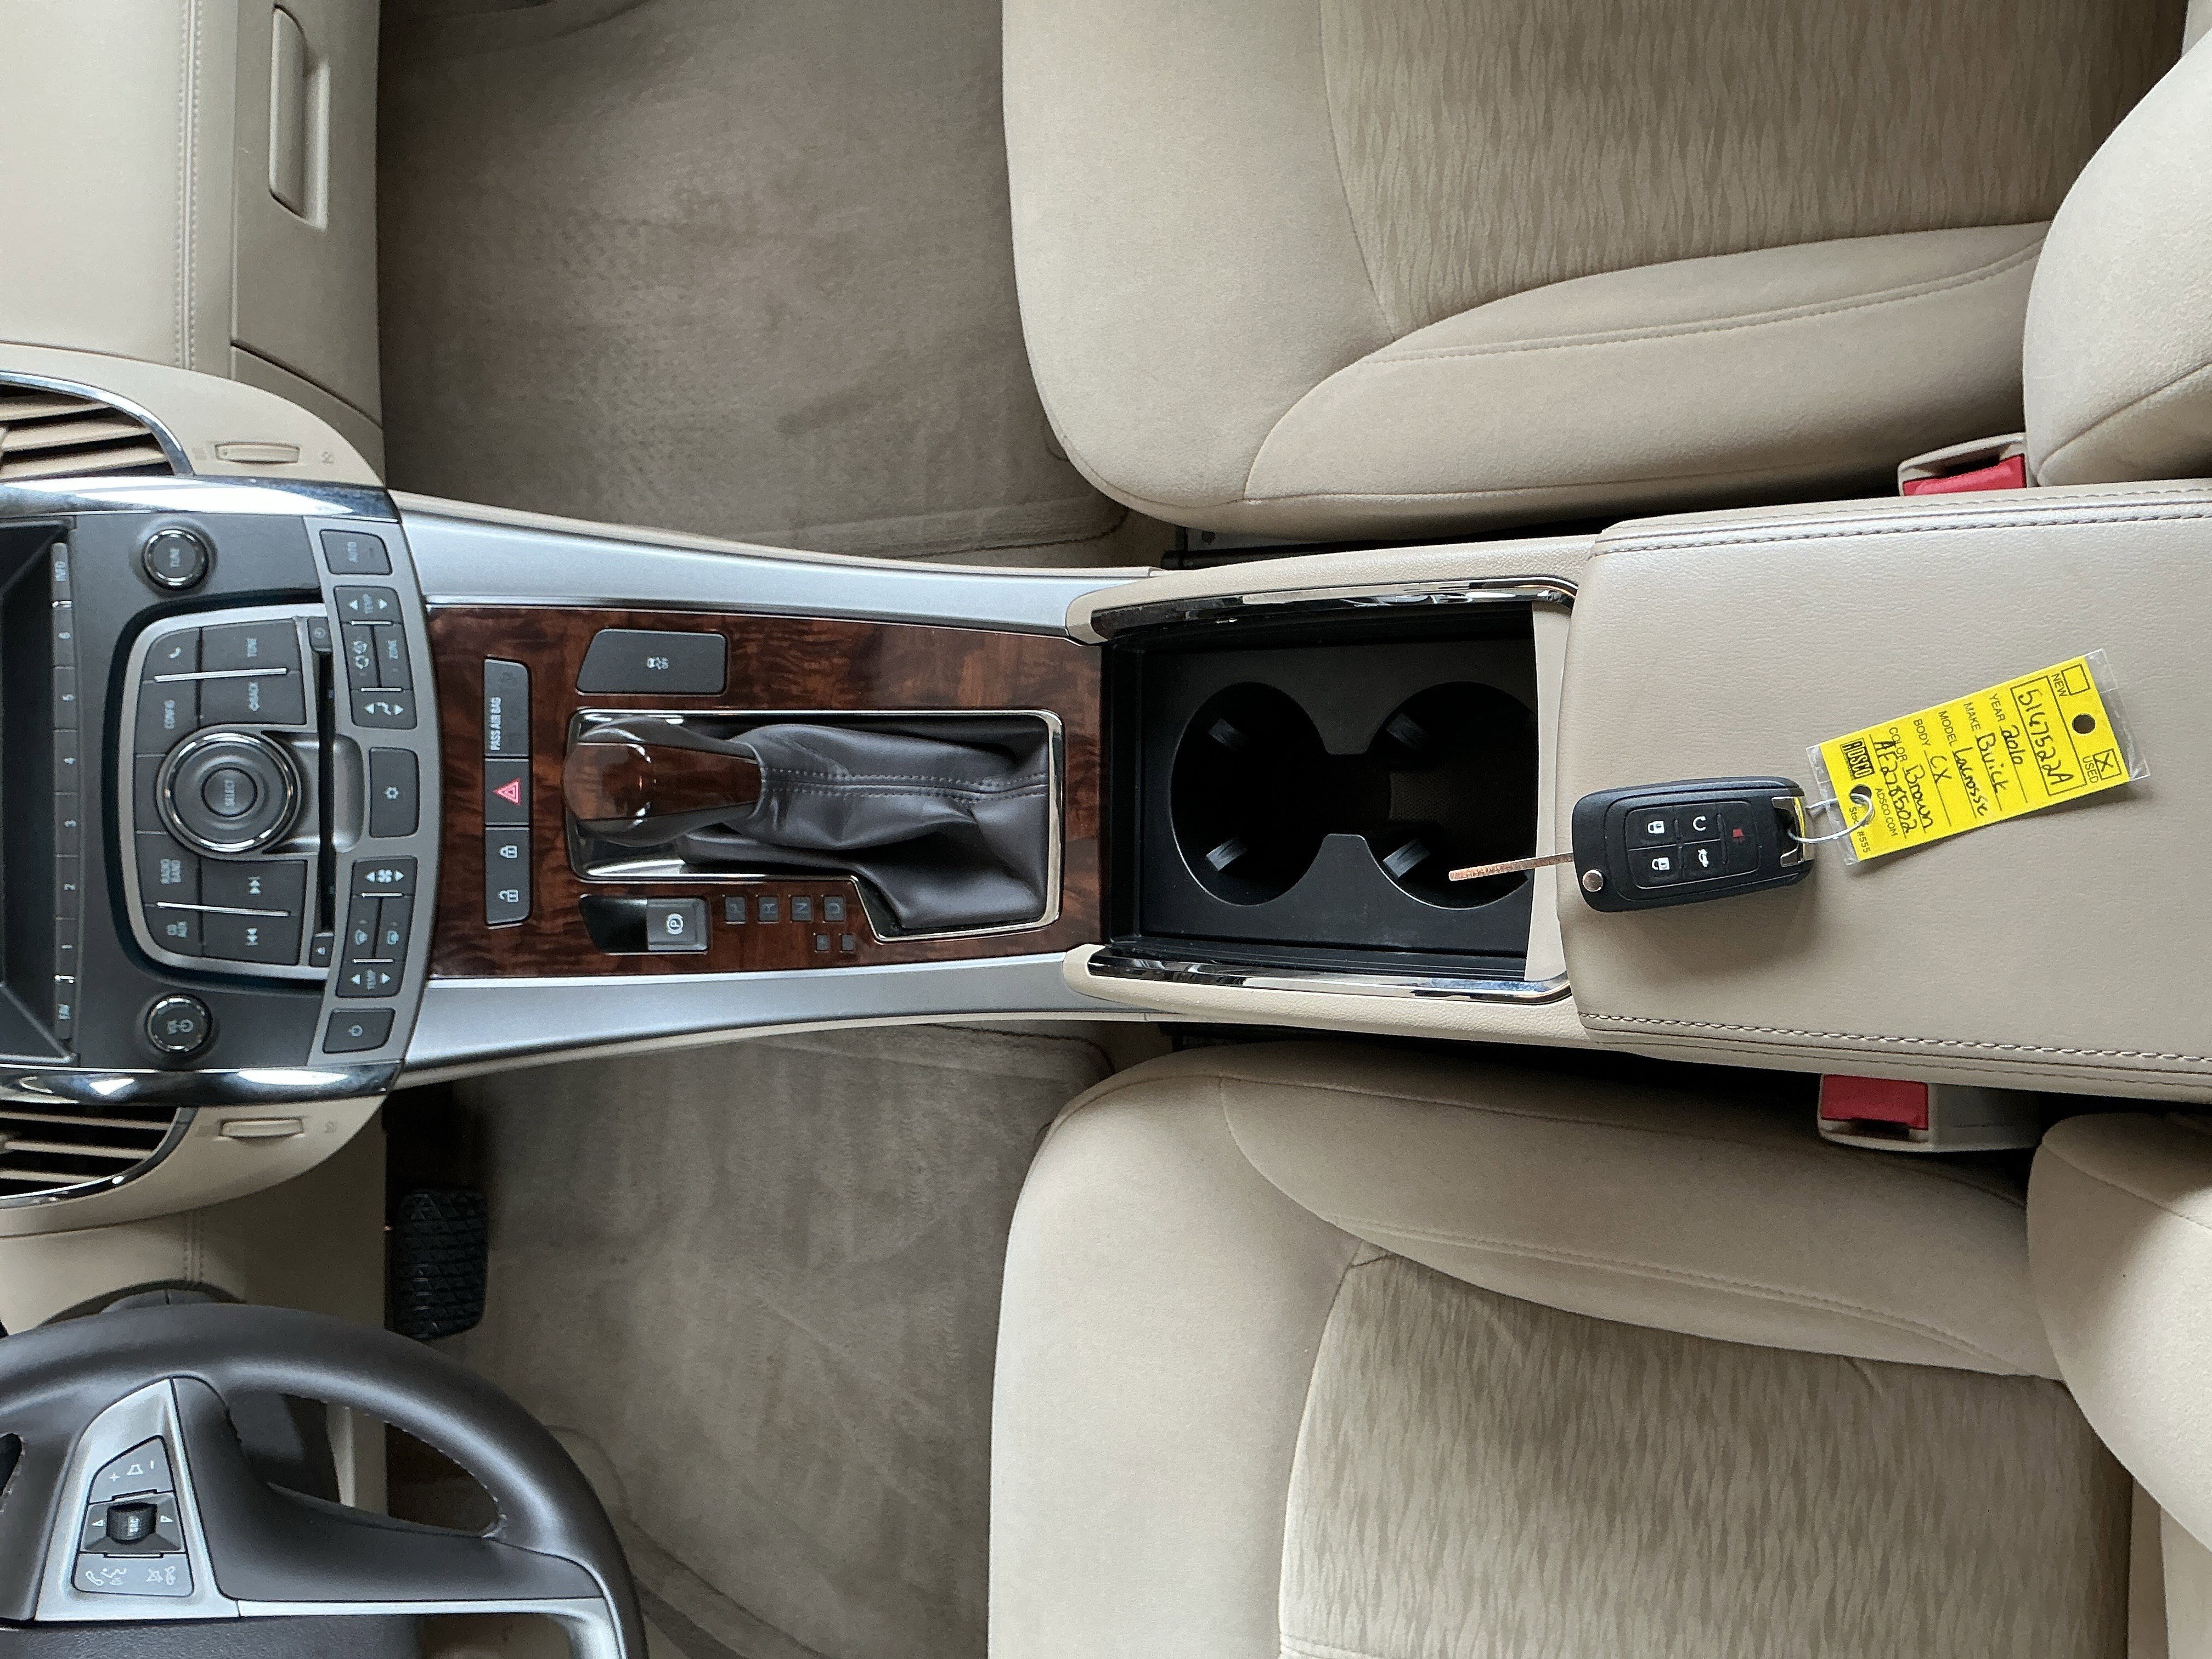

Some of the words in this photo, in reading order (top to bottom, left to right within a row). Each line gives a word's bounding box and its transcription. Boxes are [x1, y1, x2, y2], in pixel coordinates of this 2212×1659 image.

[2051, 673, 2068, 698] NEW
[490, 697, 501, 714] BAG
[1963, 702, 1981, 731] MAKE
[1988, 693, 2006, 723] YEAR
[490, 715, 501, 729] AIR
[1913, 719, 1931, 747] BODY
[1938, 710, 1959, 747] MODEL
[490, 730, 501, 751] PASS
[1888, 726, 1908, 763] COLOR
[2000, 725, 2025, 766] 2010
[1841, 741, 1872, 777] ADSCO
[1929, 755, 1953, 785] CX
[1976, 733, 2008, 794] Buick
[2082, 755, 2098, 784] USED
[1875, 787, 1898, 837] ADSCO.COM
[1904, 765, 1934, 830] Brown
[1849, 806, 1859, 828] Stoc
[1857, 831, 1871, 853] #555
